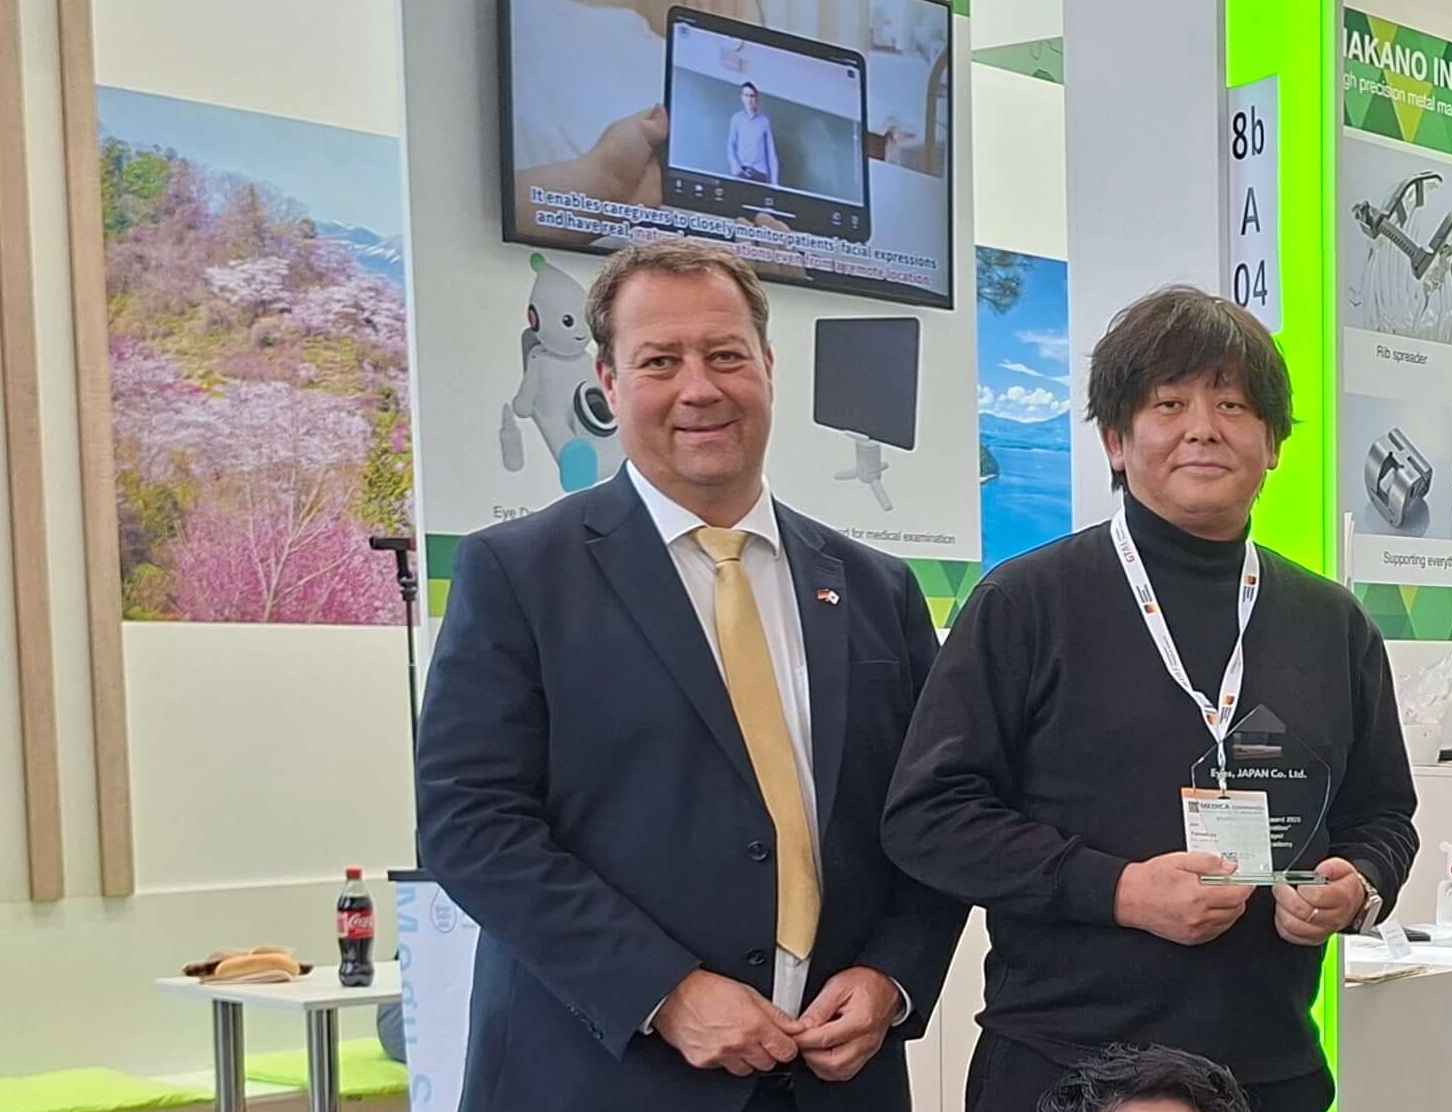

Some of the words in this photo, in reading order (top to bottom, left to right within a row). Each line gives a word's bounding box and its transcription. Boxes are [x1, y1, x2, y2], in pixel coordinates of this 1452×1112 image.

[1359, 75, 1406, 103] precision
[1407, 87, 1436, 110] metal
[537, 211, 564, 226] and
[566, 213, 601, 232] have
[1241, 186, 1261, 236] A
[530, 186, 545, 204] It
[546, 191, 600, 213] enables
[602, 200, 672, 224] caregivers
[672, 211, 688, 227] to
[689, 214, 734, 239] closely
[735, 224, 784, 245] monitor
[841, 241, 872, 259] facial
[873, 250, 937, 270] expressions
[1233, 259, 1268, 308] 04
[1376, 345, 1390, 359] Rib
[1392, 351, 1428, 366] spreader
[866, 529, 901, 542] medical
[903, 531, 956, 545] examination
[1383, 551, 1427, 569] Supporting
[1237, 768, 1269, 779] JAPAN
[1270, 768, 1288, 779] Co.
[1288, 769, 1308, 779] Ltd.
